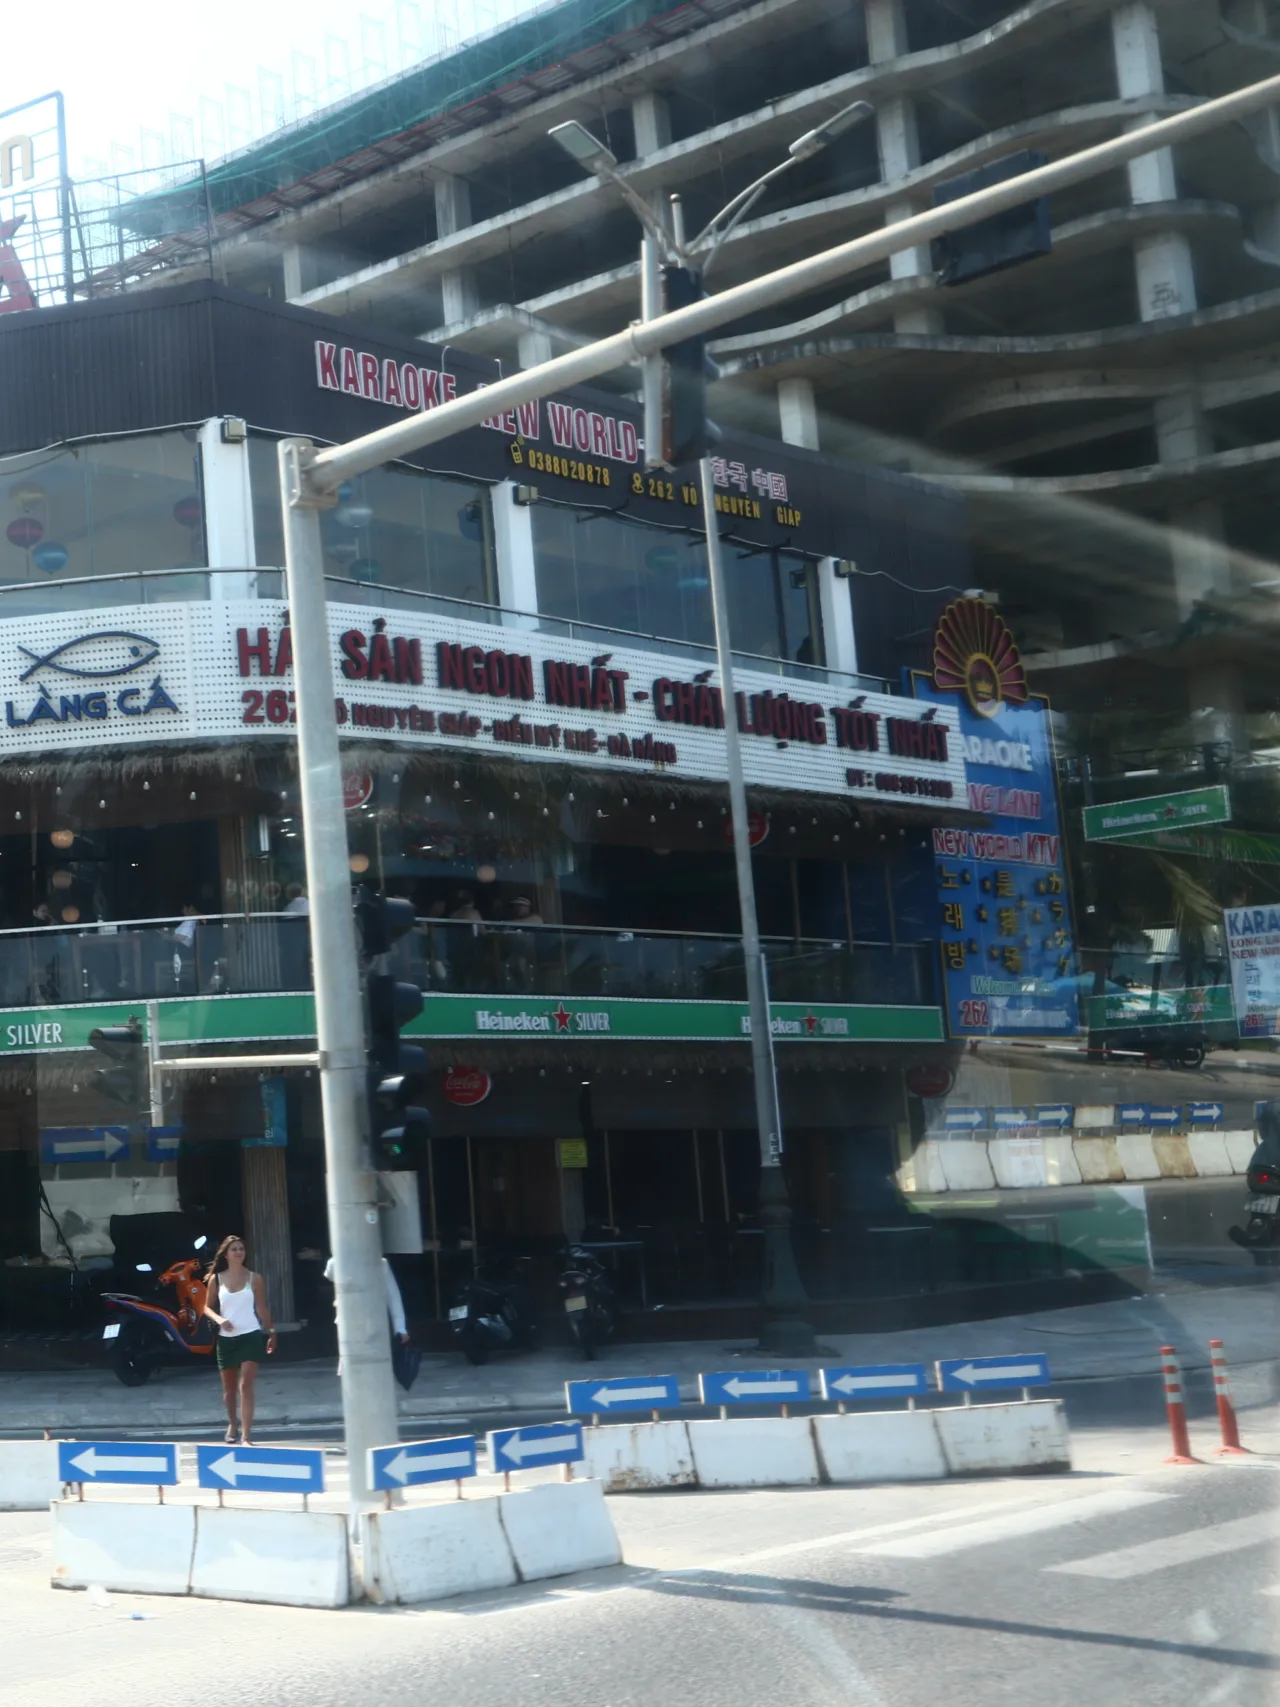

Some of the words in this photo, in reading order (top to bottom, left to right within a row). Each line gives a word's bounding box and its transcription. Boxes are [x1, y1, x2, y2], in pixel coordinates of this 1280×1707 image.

[314, 340, 456, 413] KARAOKE
[528, 449, 611, 487] 0388020878
[648, 478, 674, 501] 262
[340, 617, 423, 685] SẢN
[436, 640, 534, 700] NGON
[543, 653, 629, 714] NHẤT
[653, 669, 727, 730] CHẤT
[734, 689, 827, 750] LƯỢNG
[830, 695, 881, 752] TỐT
[886, 707, 950, 762] NHẤT
[961, 735, 1033, 772] ARAOKE
[932, 828, 968, 856] NEW
[970, 832, 1022, 860] WORLD
[1023, 831, 1060, 865] KTV
[476, 1010, 551, 1031] Heineken
[576, 1012, 611, 1031] SILVER
[741, 1016, 801, 1034] Heken
[959, 1000, 990, 1028] 262
[7, 1023, 63, 1046] SILVER
